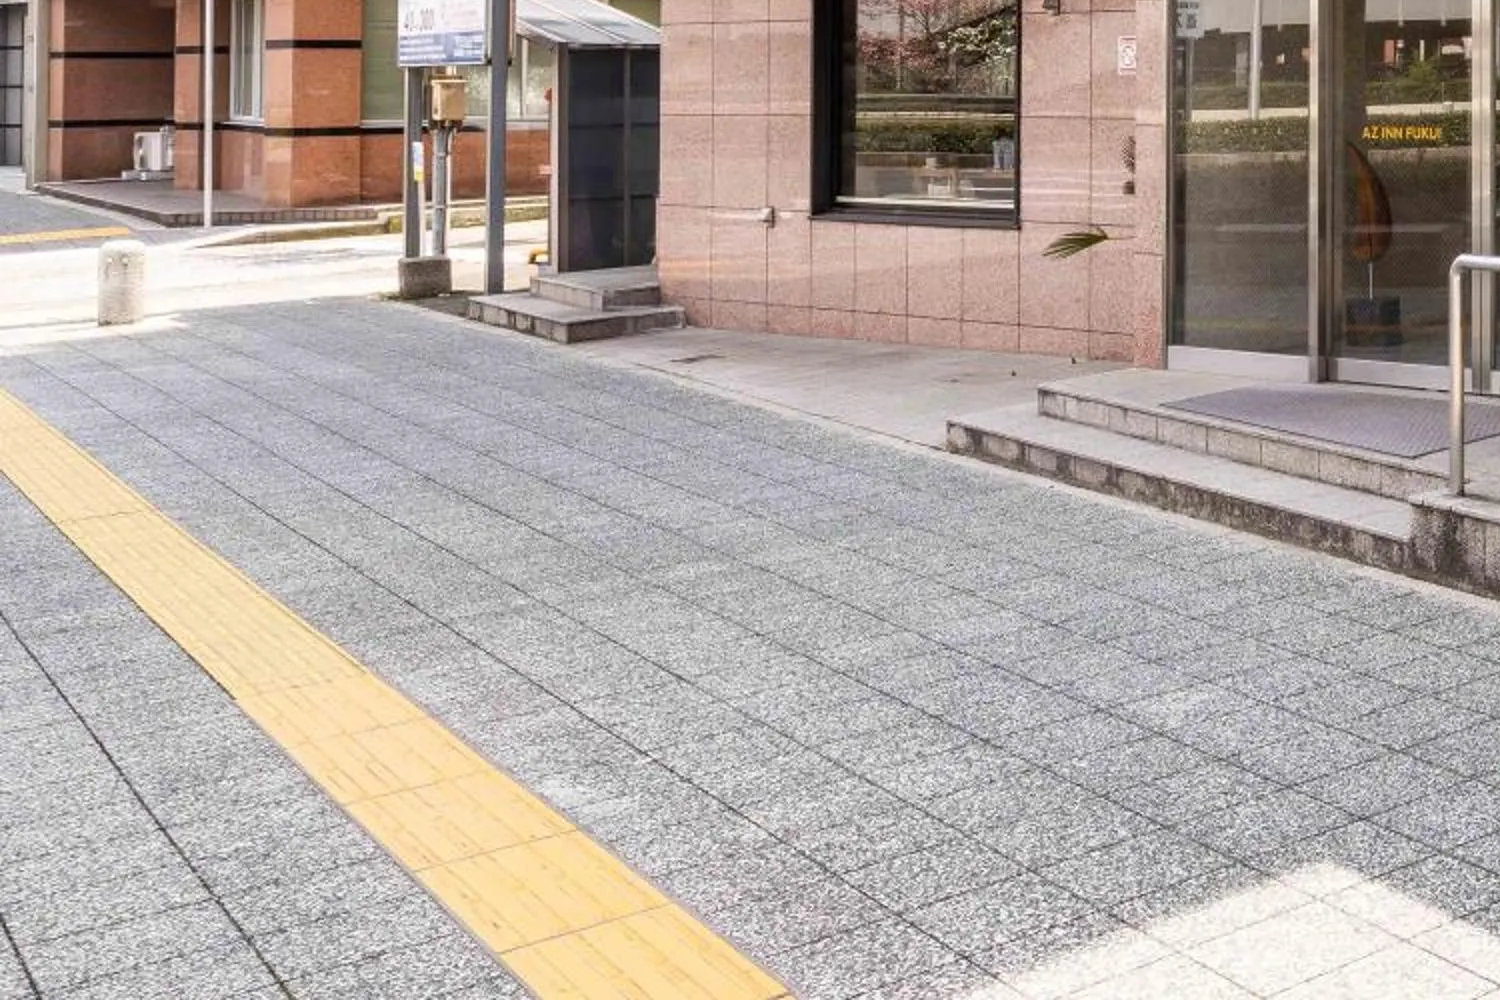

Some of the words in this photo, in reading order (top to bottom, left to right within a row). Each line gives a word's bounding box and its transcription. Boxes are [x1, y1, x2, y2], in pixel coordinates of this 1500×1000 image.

[1362, 126, 1380, 140] AZ
[1382, 125, 1403, 140] INN
[1405, 126, 1442, 141] FUKUI
